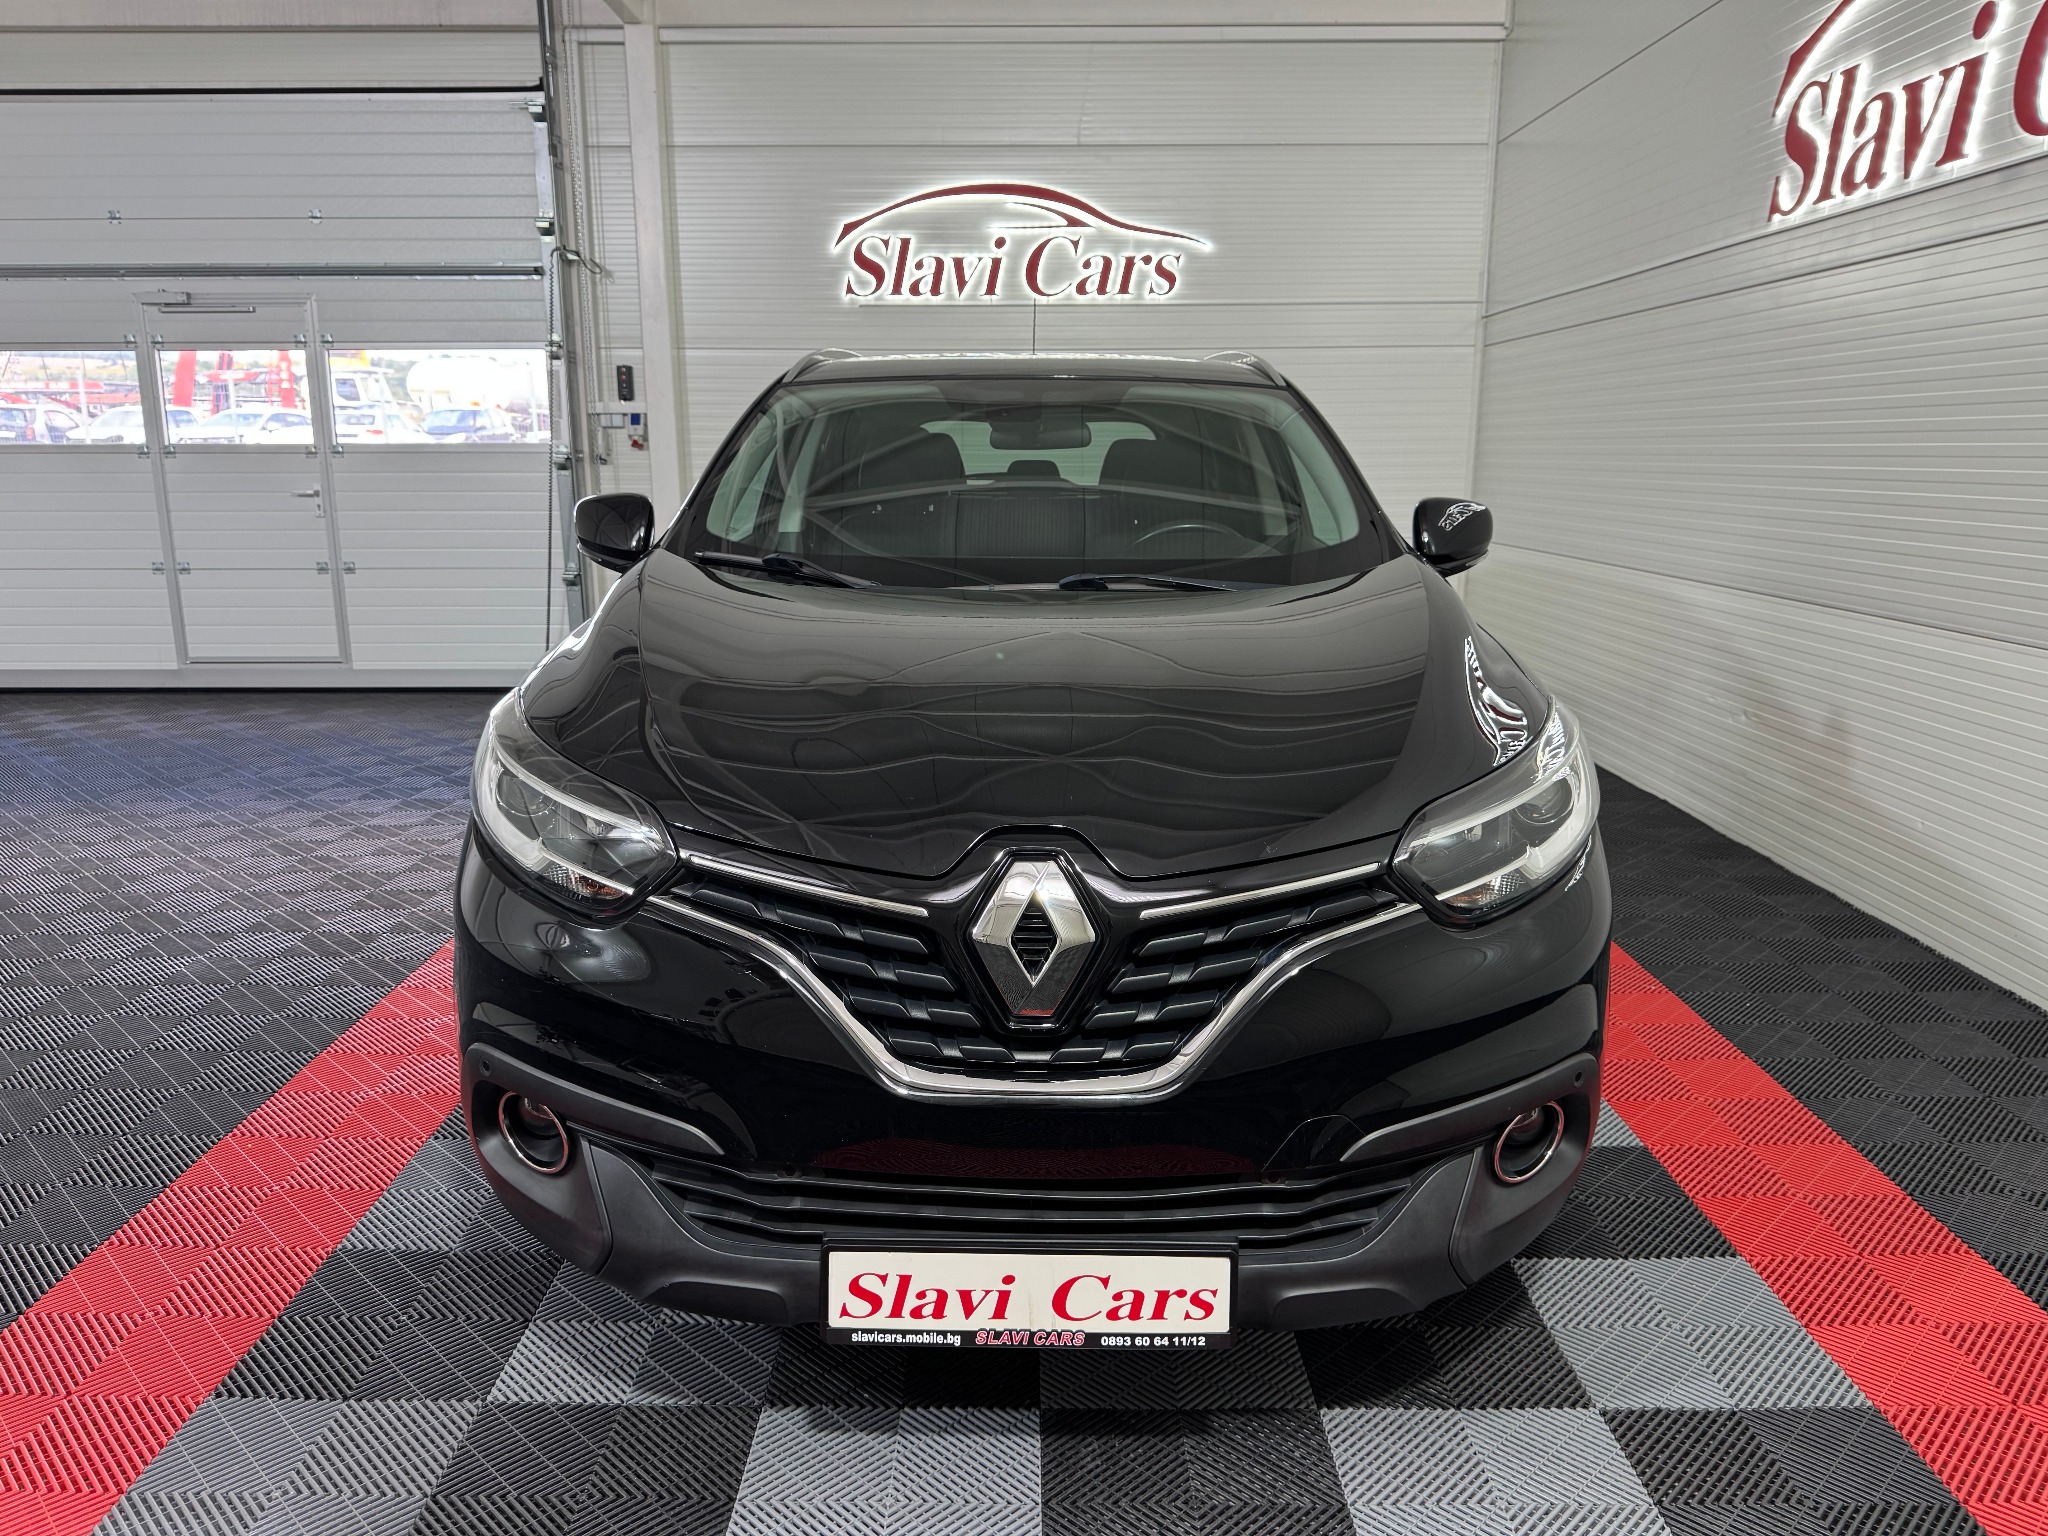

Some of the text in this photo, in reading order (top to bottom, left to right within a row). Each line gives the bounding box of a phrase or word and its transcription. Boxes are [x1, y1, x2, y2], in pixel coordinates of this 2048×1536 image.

[1766, 0, 1997, 223] Slavi
[845, 235, 1182, 298] Slavi Cars
[838, 1272, 1219, 1322] Slavi Cars
[851, 1331, 961, 1346] slavicars.mobile.bg
[975, 1330, 1086, 1346] SLAVI CARS
[1100, 1336, 1206, 1346] 0893 60 64 11/12
